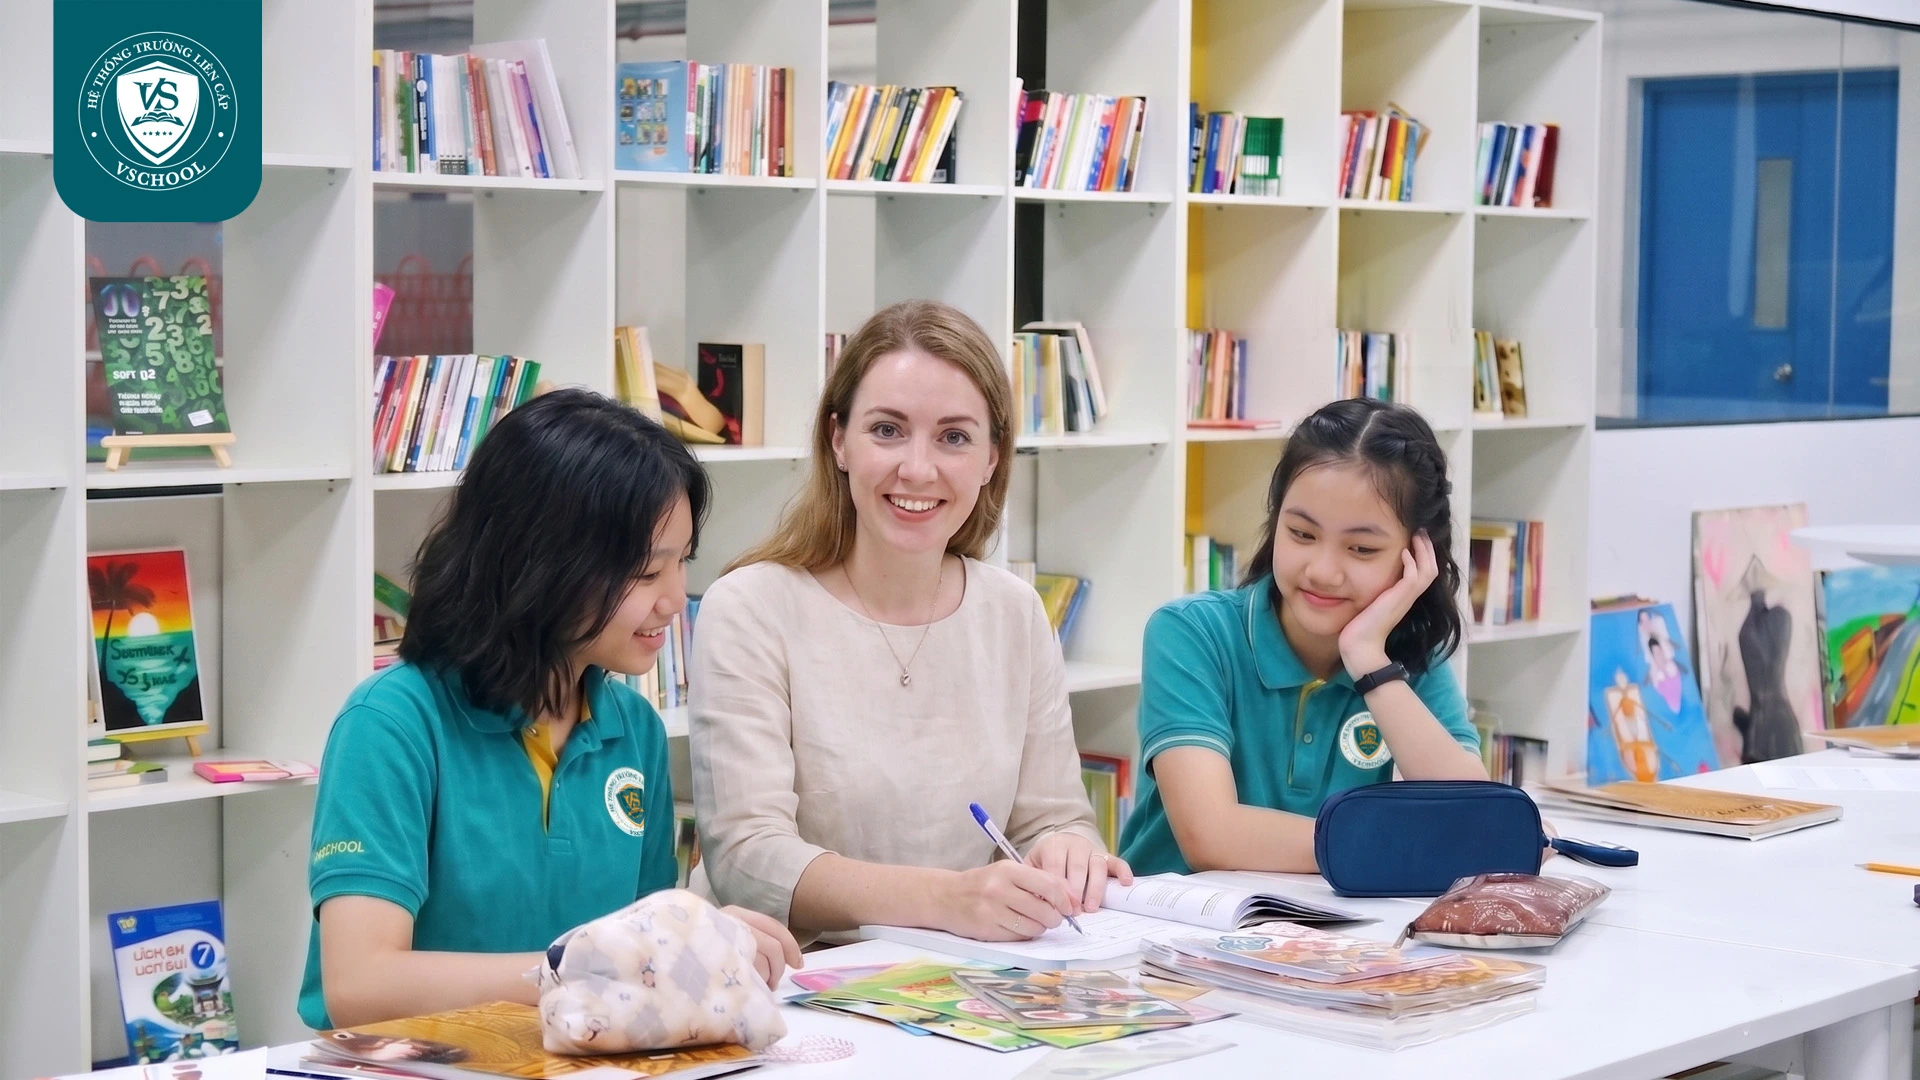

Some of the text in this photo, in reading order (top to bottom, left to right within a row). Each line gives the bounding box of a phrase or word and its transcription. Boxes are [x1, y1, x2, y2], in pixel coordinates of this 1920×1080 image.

[145, 316, 167, 341] 2
[145, 342, 165, 366] 5
[197, 943, 211, 966] 7
